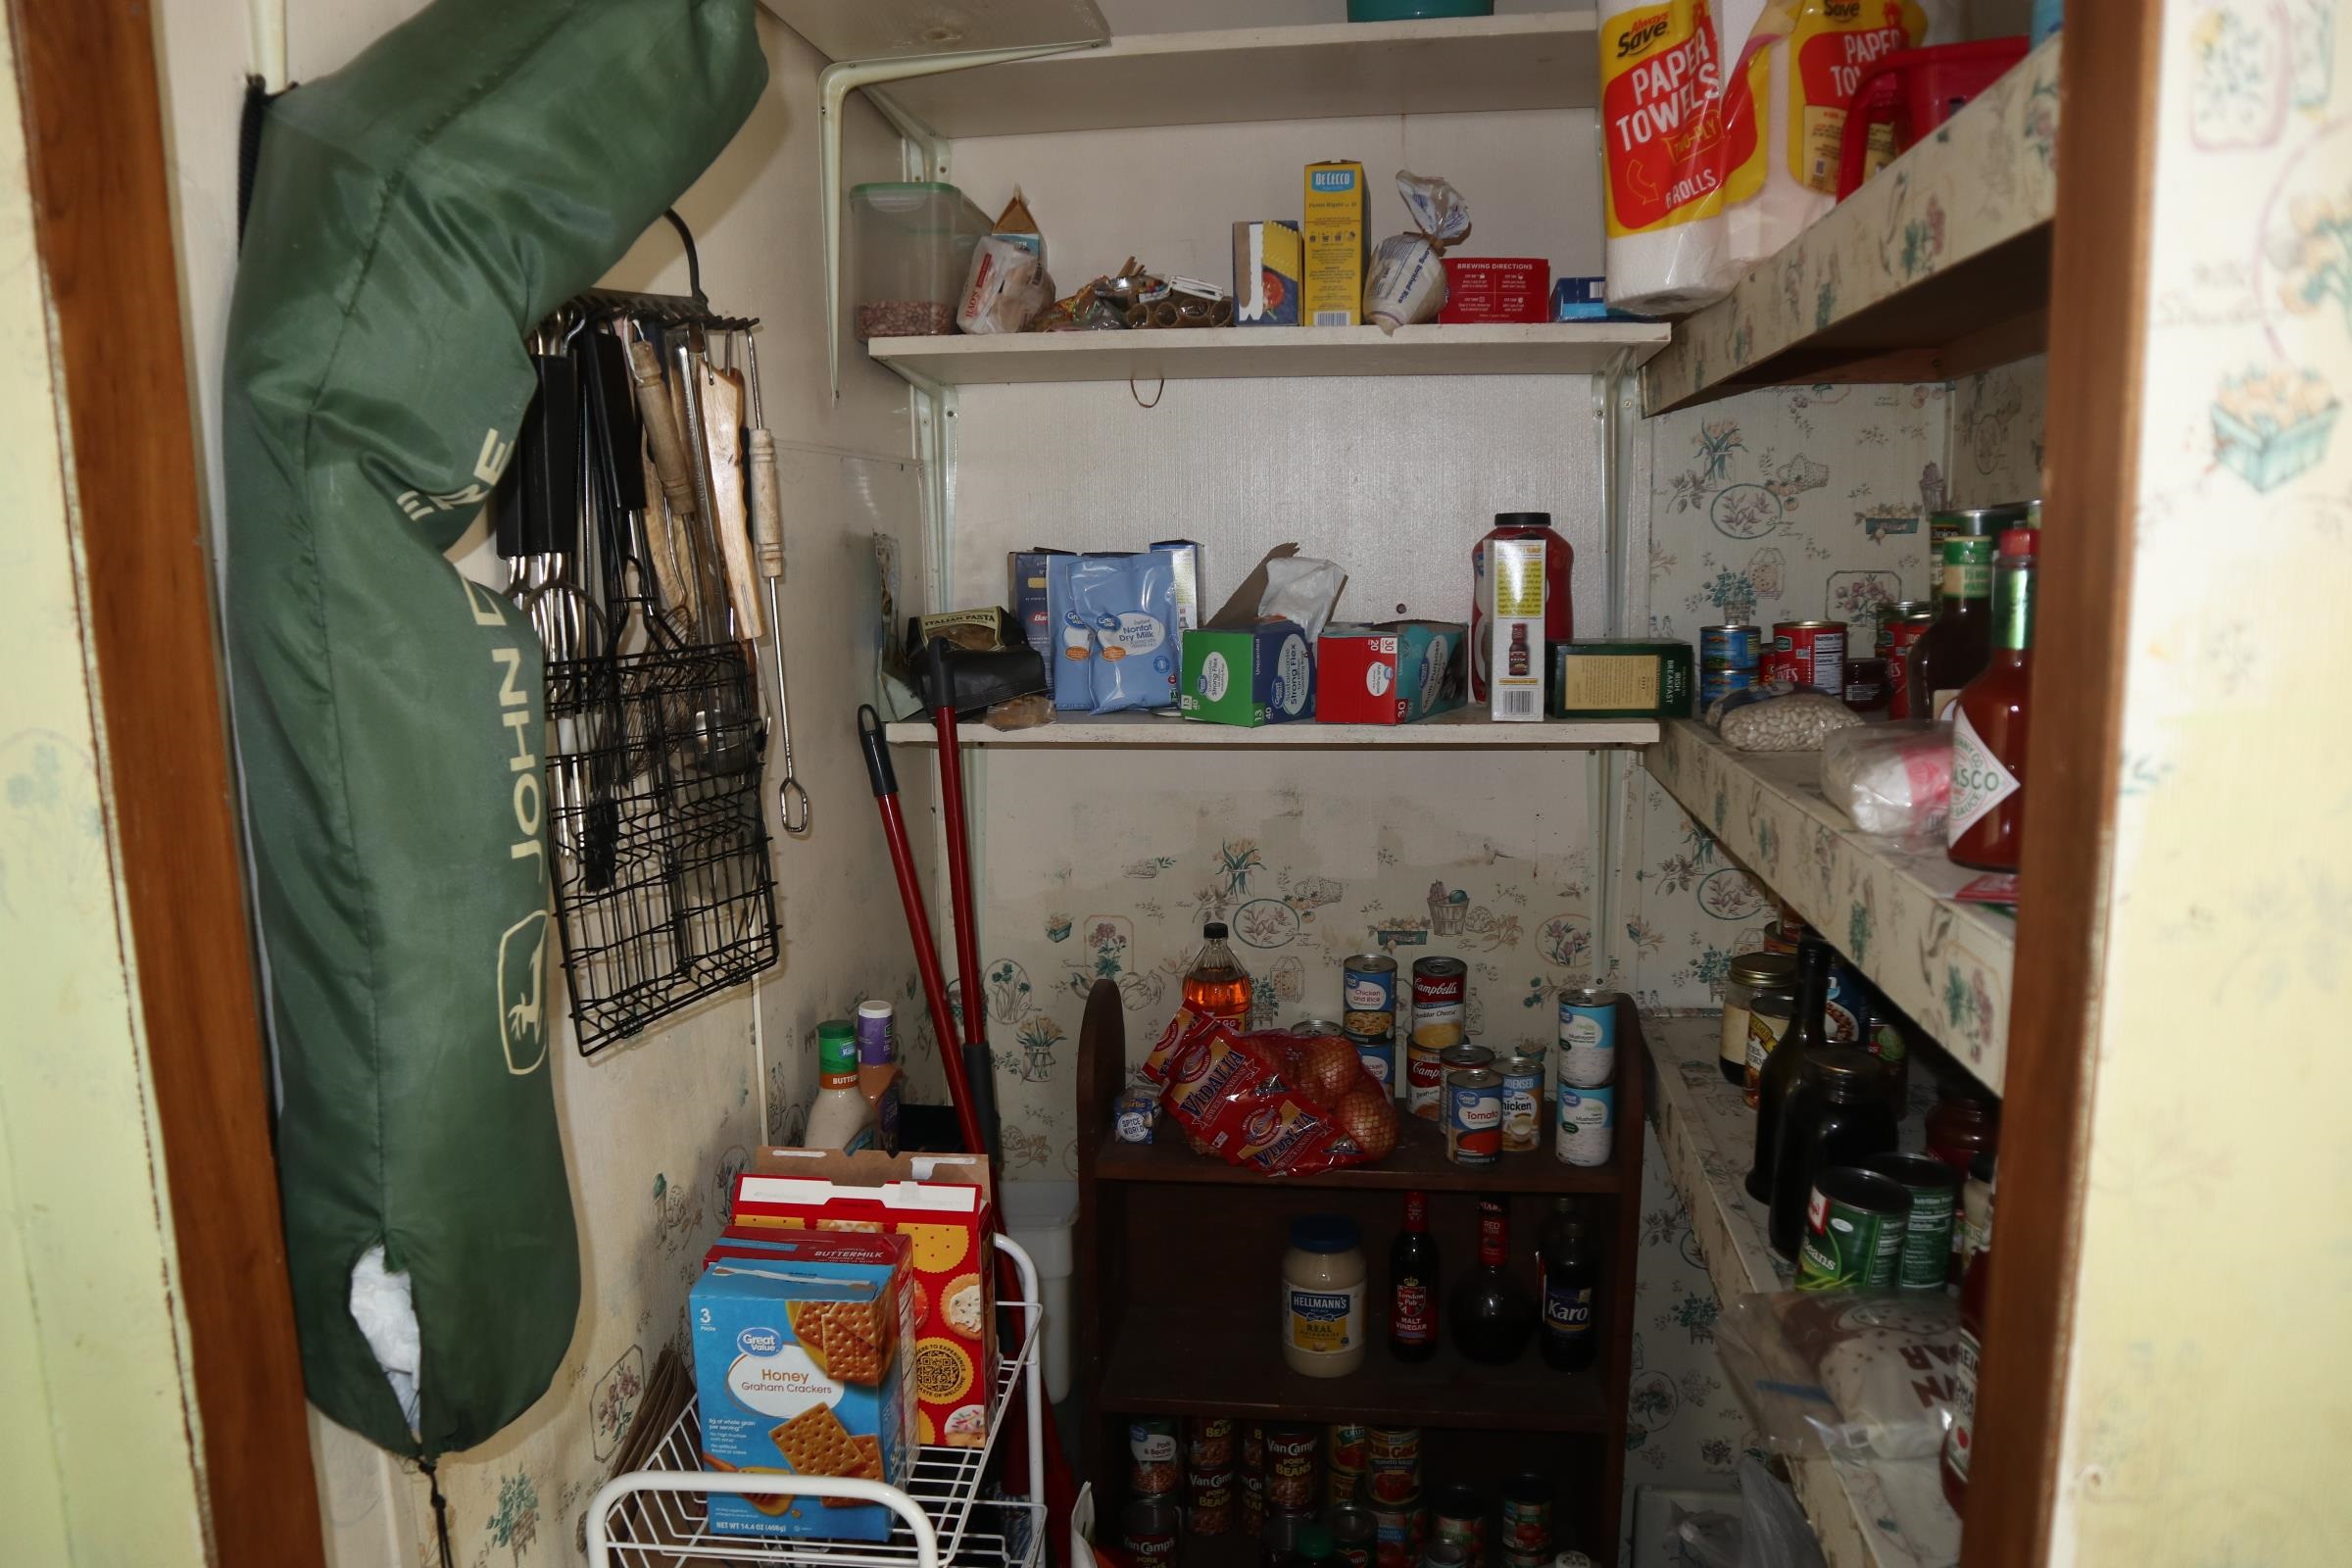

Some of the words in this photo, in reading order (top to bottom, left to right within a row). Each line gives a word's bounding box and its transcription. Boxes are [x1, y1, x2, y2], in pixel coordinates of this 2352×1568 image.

[1617, 21, 1668, 57] Save
[1632, 26, 1710, 106] PAPER
[1616, 63, 1720, 153] TOWELS
[1672, 169, 1716, 204] ROLLS
[924, 615, 962, 626] ITALIAN
[965, 613, 996, 622] PASTA
[1123, 623, 1152, 634] Nonfat
[1384, 639, 1395, 652] 30
[1665, 659, 1674, 703] BREAKFAST
[1397, 701, 1406, 718] 30
[492, 646, 545, 884] JOHN
[1180, 1050, 1247, 1117] VIDALIA
[1122, 1117, 1141, 1127] SPICE
[1467, 1109, 1498, 1120] Tomato
[1123, 1124, 1145, 1135] WORLD
[1294, 1295, 1347, 1309] HELLMANN'S
[700, 1307, 711, 1324] 3
[1548, 1299, 1588, 1323] Karo
[1306, 1324, 1332, 1333] REAL
[1396, 1322, 1428, 1332] VINEGAR
[742, 1333, 776, 1347] Great
[751, 1343, 776, 1352] Value
[939, 1345, 966, 1373] EXPERIENCE
[761, 1368, 809, 1384] Honey
[741, 1382, 784, 1394] Graham
[787, 1383, 832, 1395] Crackers
[944, 1377, 966, 1398] WELCOME
[1275, 1462, 1312, 1477] BEANS
[715, 1521, 729, 1530] NET
[729, 1521, 740, 1530] WT
[741, 1522, 755, 1531] 14.4
